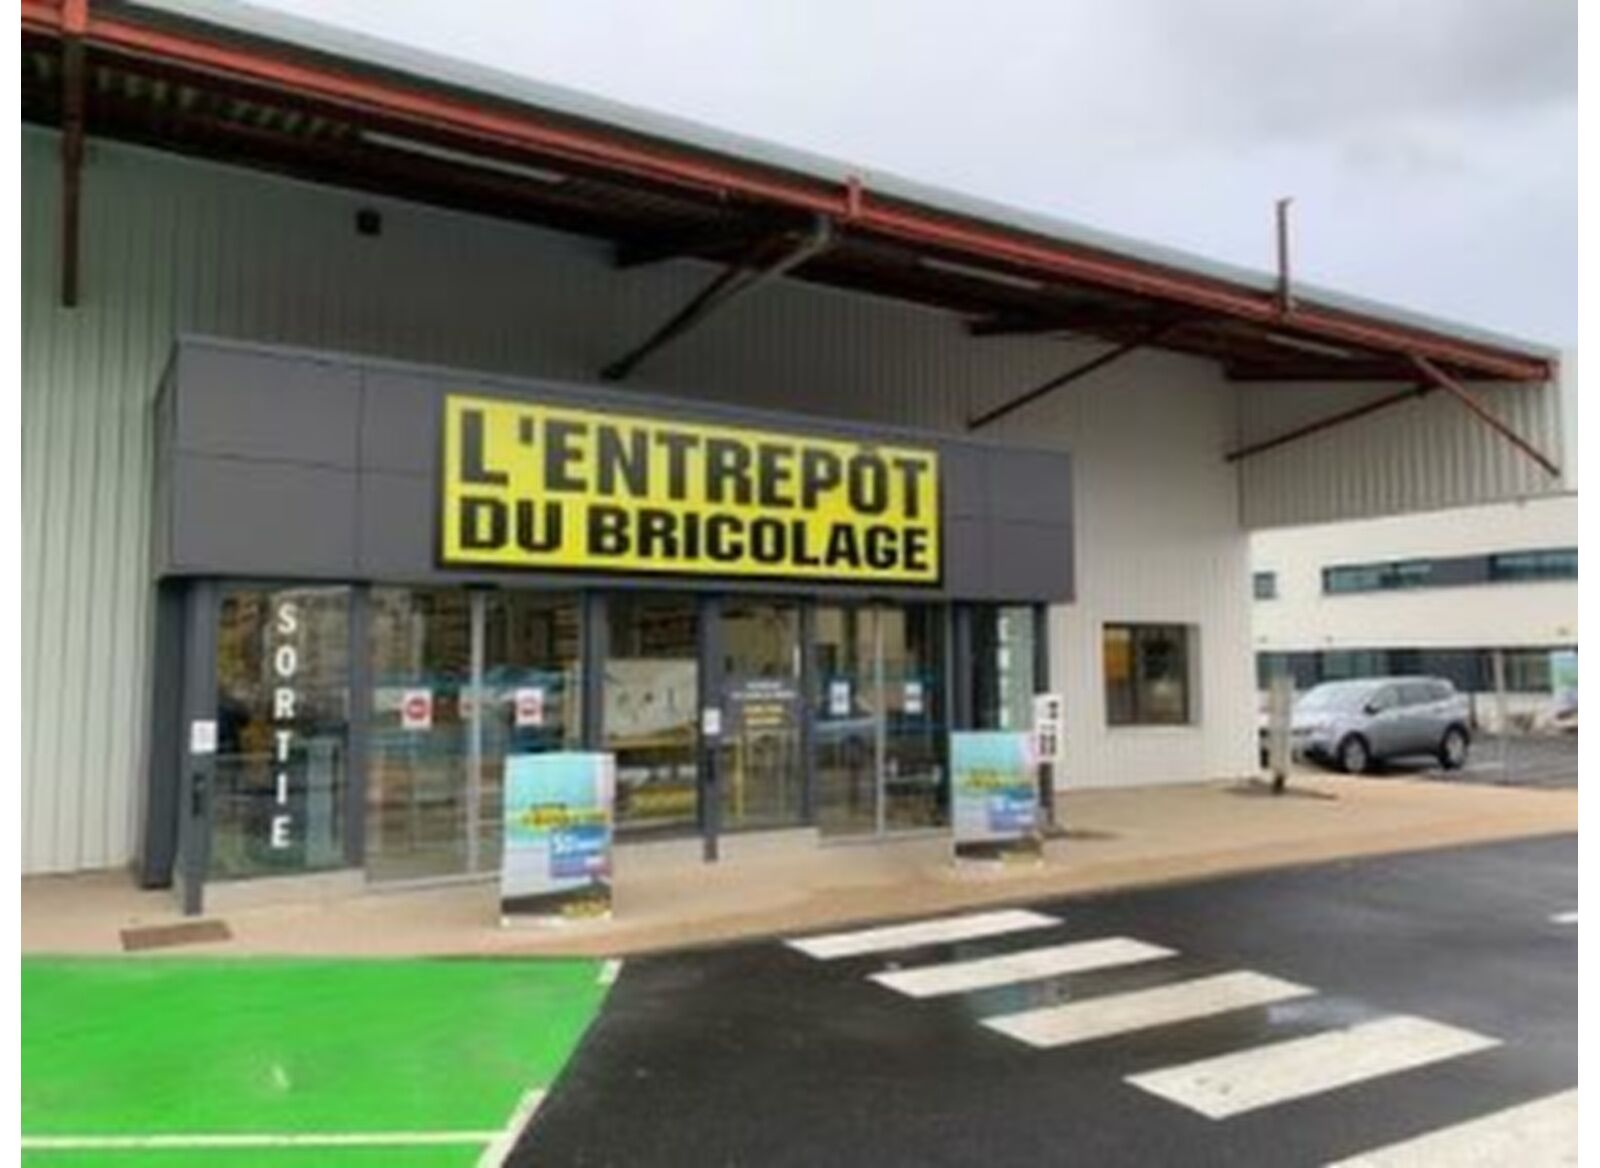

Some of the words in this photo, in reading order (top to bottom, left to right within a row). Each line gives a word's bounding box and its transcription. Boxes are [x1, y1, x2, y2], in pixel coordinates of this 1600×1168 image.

[460, 409, 928, 518] L'ENTREPÔT
[459, 495, 562, 553] DU
[587, 505, 928, 571] BRICOLAGE
[271, 603, 297, 849] SORTIE
